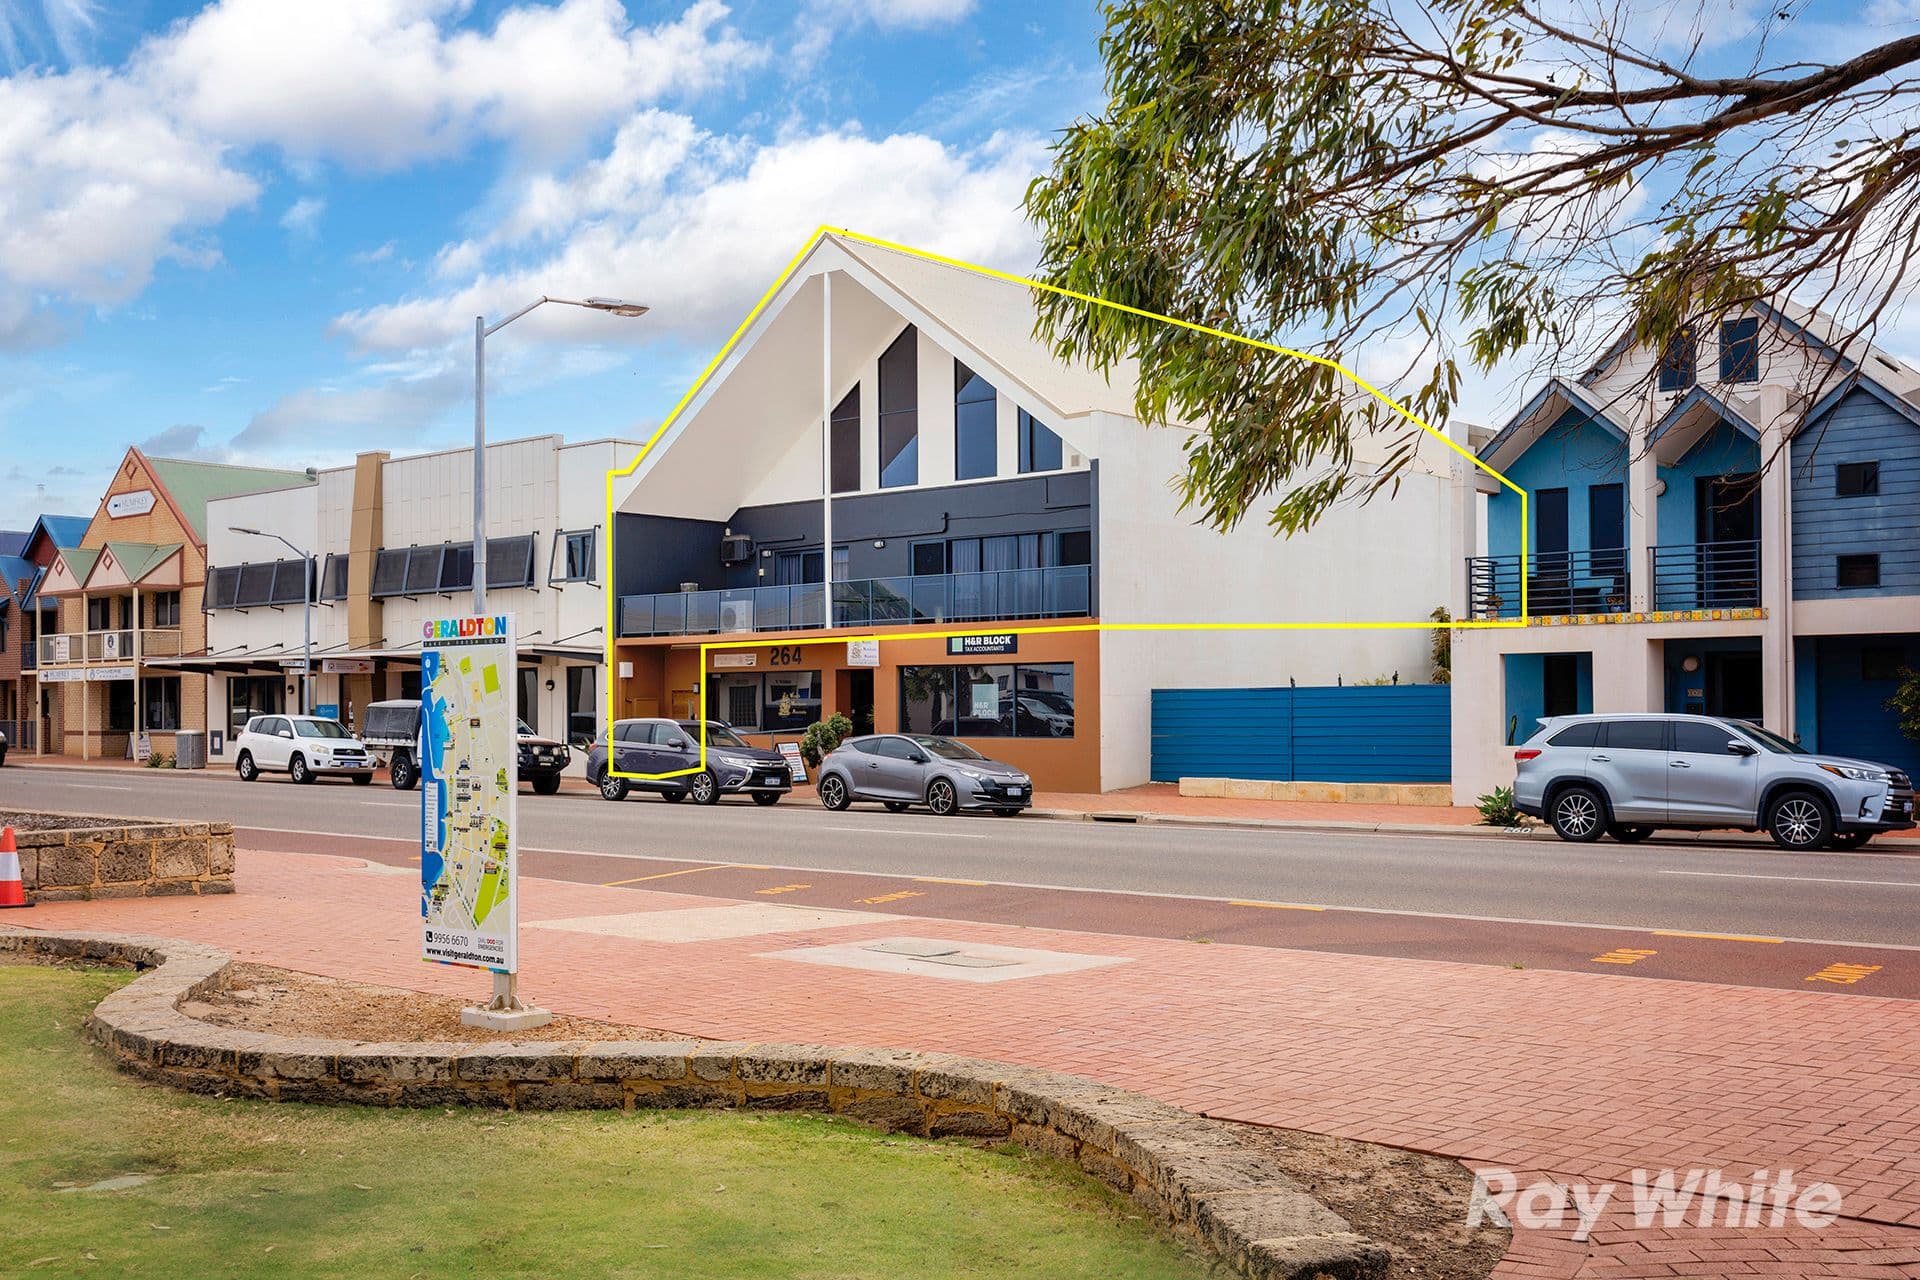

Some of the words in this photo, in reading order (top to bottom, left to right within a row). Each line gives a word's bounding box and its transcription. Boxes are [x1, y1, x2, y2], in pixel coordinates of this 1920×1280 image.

[423, 616, 506, 639] GERALDTON
[964, 636, 982, 646] H&R
[983, 635, 1012, 645] BLOCK
[770, 646, 802, 666] 264
[433, 932, 450, 945] 9956
[451, 935, 468, 947] 6670
[426, 947, 504, 965] www.visitgeraldton.com.au
